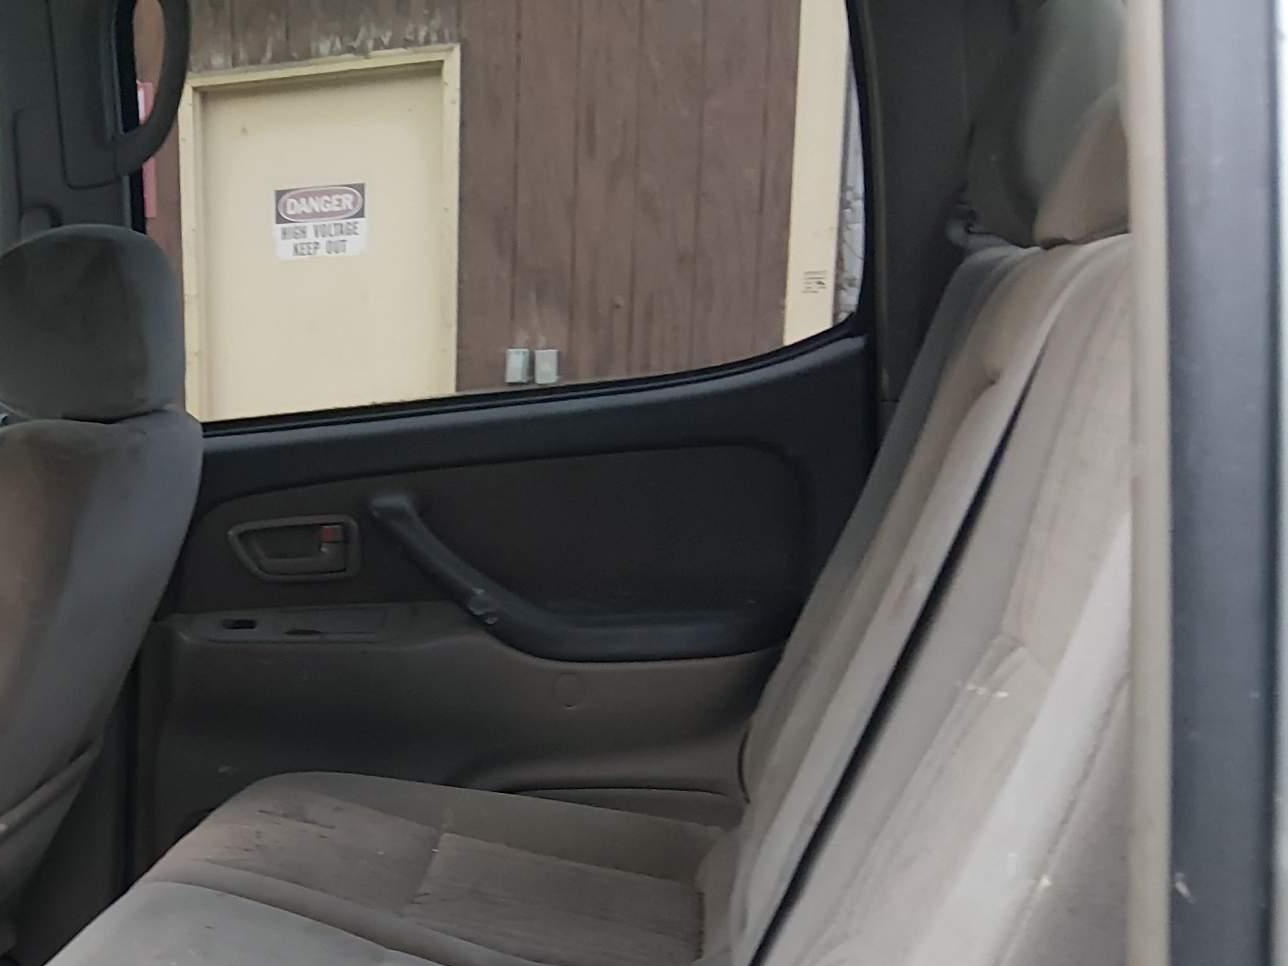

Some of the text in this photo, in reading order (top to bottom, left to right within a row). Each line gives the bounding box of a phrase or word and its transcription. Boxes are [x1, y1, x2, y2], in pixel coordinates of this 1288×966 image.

[285, 193, 354, 215] DANGER
[280, 221, 360, 240] HIGH VOLTAGE
[292, 239, 347, 256] KEEP OUT
